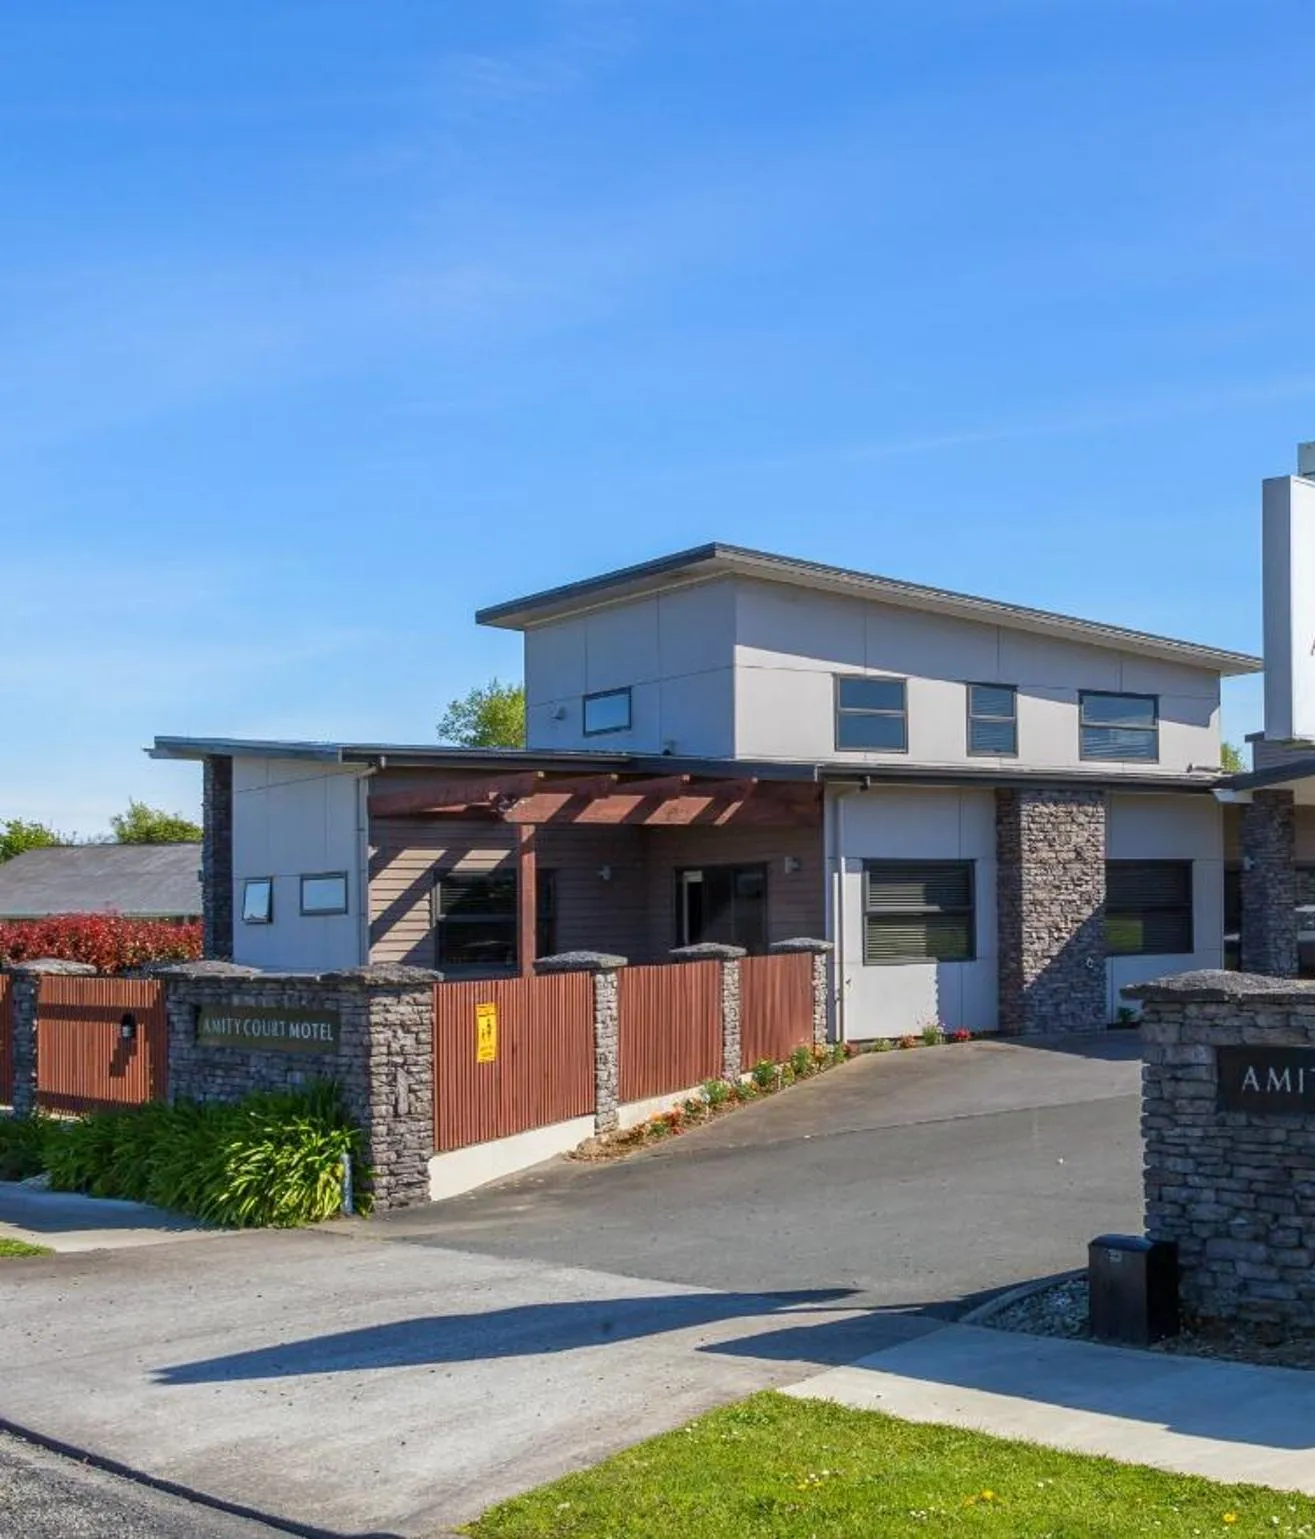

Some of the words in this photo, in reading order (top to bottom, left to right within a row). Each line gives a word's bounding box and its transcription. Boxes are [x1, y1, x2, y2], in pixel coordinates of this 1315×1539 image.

[203, 1017, 241, 1035] AMITY
[243, 1018, 286, 1038] COURT
[289, 1021, 334, 1041] MOTEL
